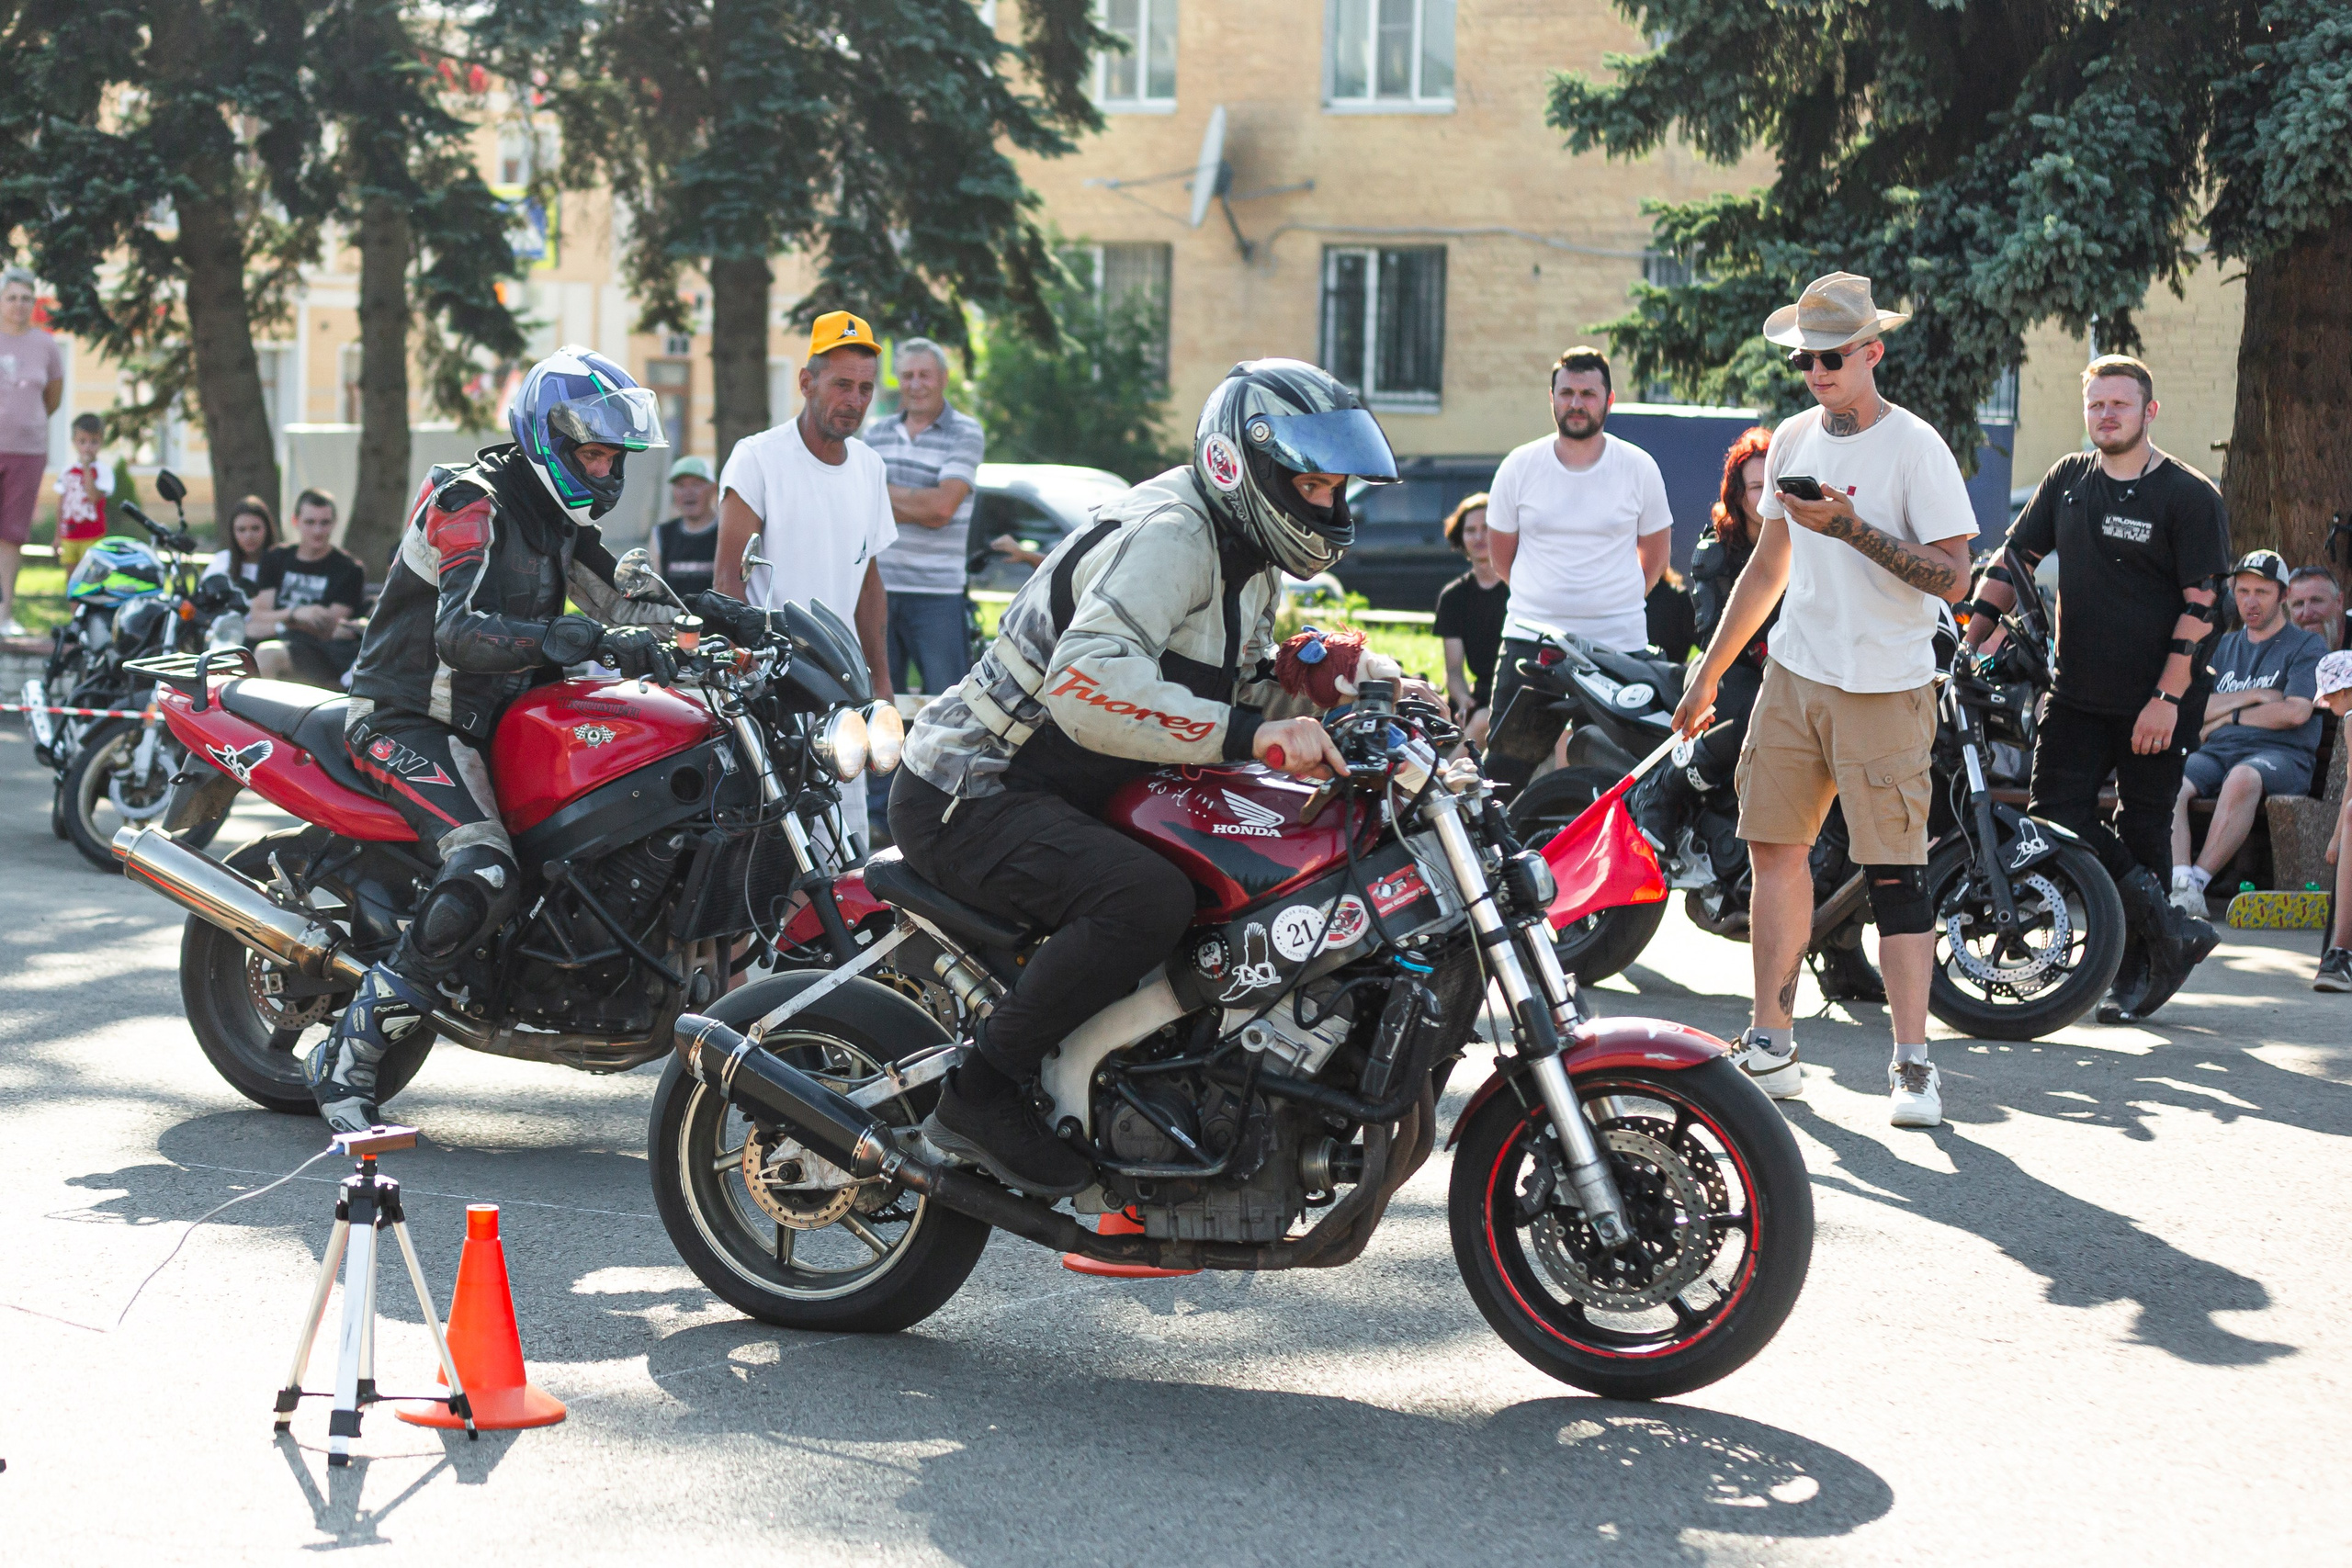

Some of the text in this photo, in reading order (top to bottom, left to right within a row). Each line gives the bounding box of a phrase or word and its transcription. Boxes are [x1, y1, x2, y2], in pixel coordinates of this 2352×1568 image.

[557, 697, 641, 719] TRIUMPH
[1212, 823, 1283, 838] HONDA
[1286, 919, 1316, 948] 21
